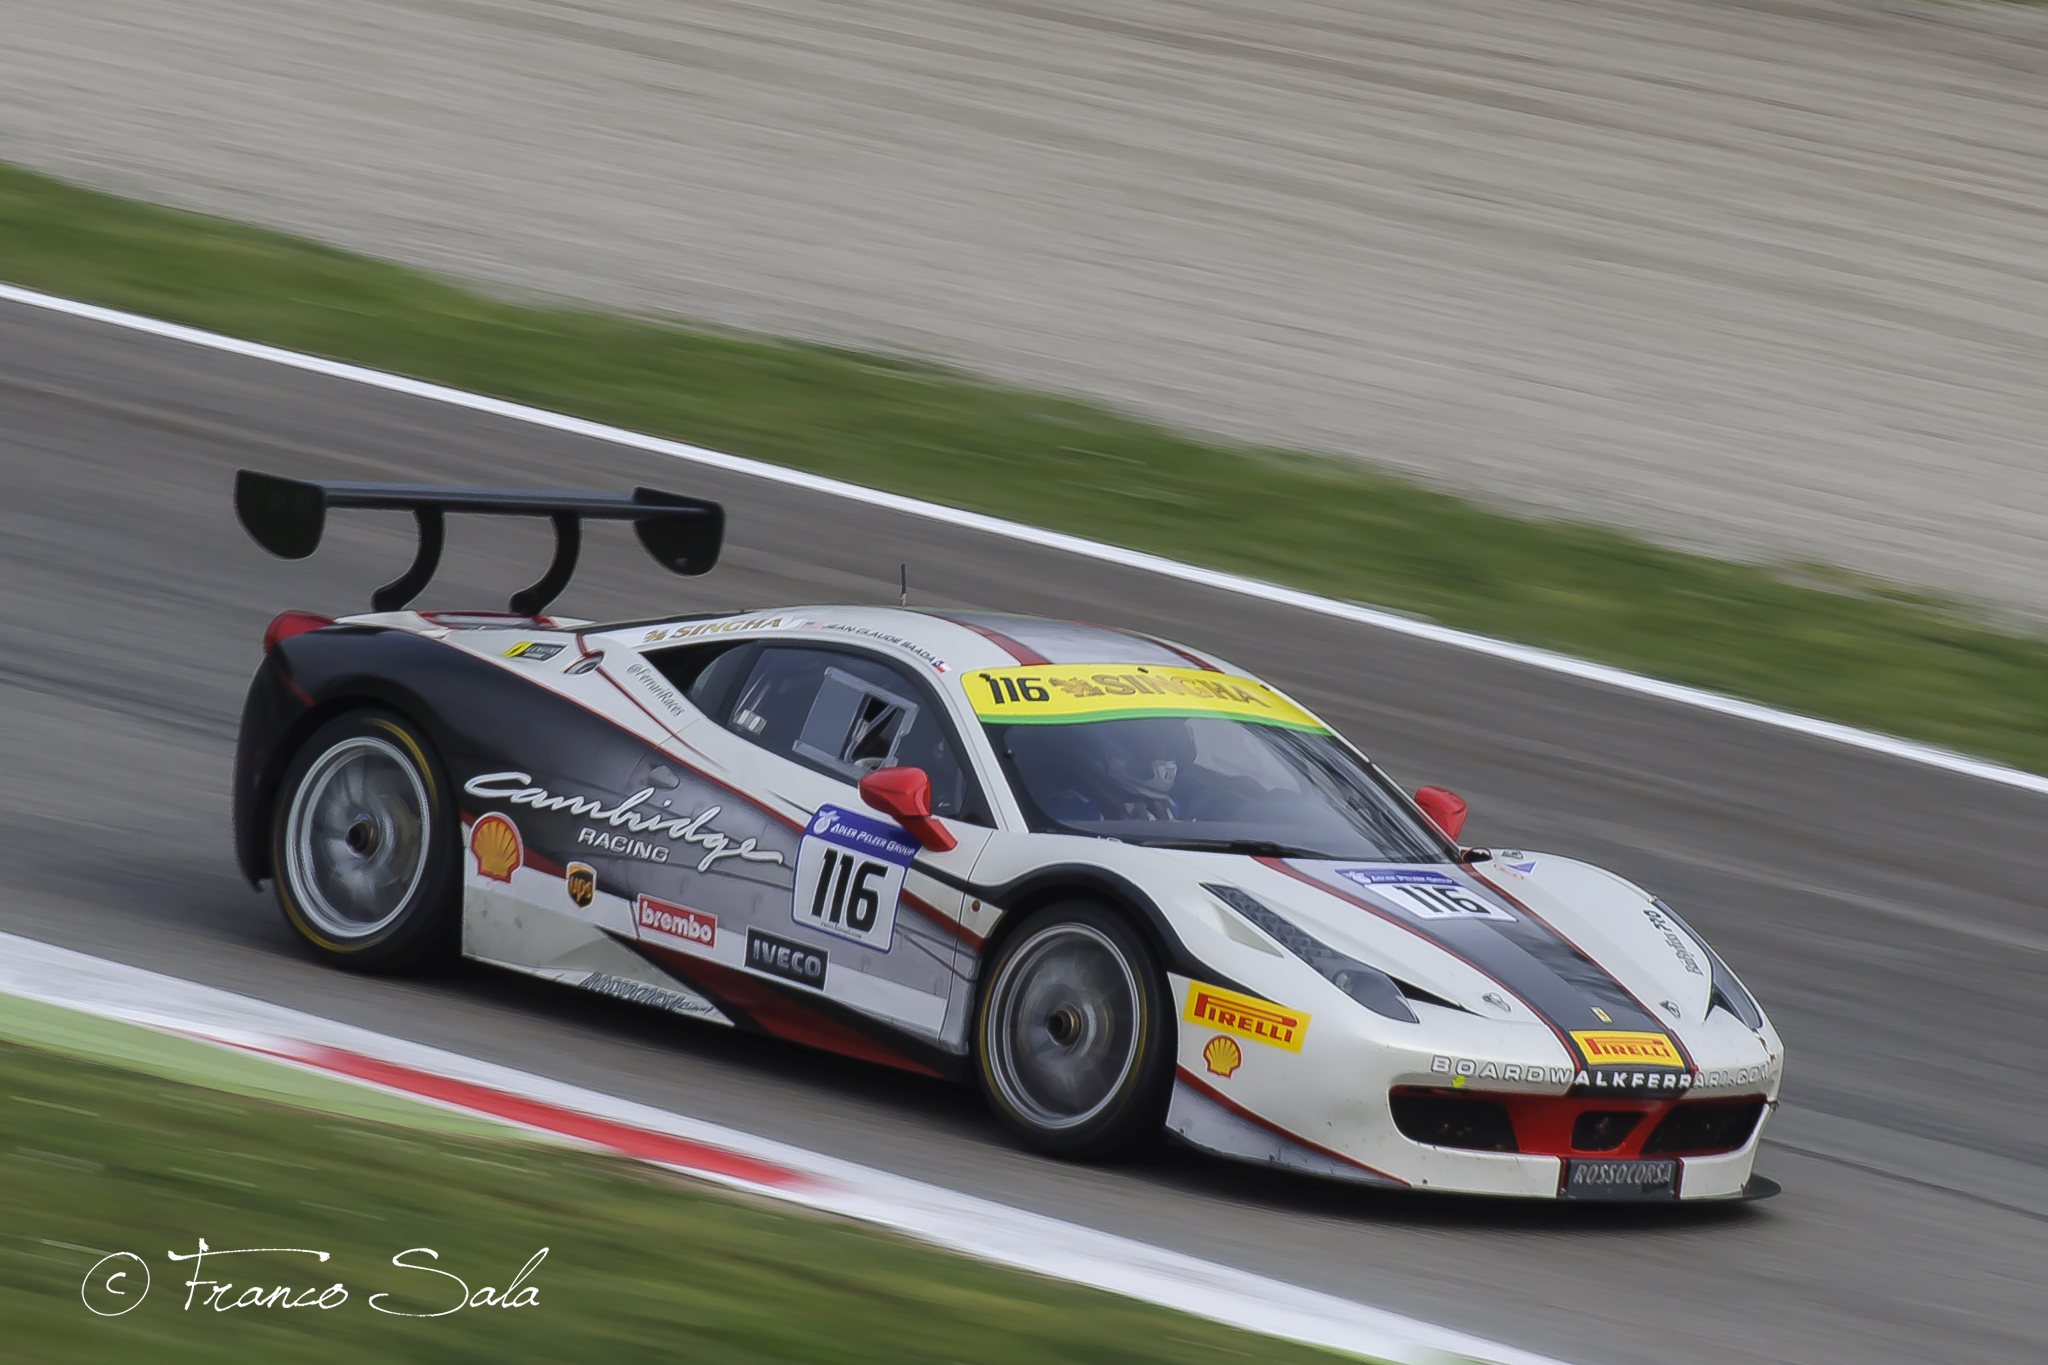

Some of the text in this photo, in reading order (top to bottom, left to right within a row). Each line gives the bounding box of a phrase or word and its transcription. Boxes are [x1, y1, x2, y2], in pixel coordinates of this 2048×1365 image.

[669, 618, 783, 639] SINGHA
[979, 673, 1271, 708] 116 SINGHA
[463, 770, 785, 875] Cambridge
[578, 827, 670, 863] RACING
[569, 875, 592, 902] ups
[810, 846, 889, 933] 116
[1391, 884, 1491, 916] 116
[640, 902, 713, 944] brembo
[752, 938, 822, 977] IVECO
[1194, 992, 1298, 1043] PIRELLI
[1584, 1037, 1671, 1059] PIRELLI
[1573, 1163, 1673, 1186] ROSSOCORSA
